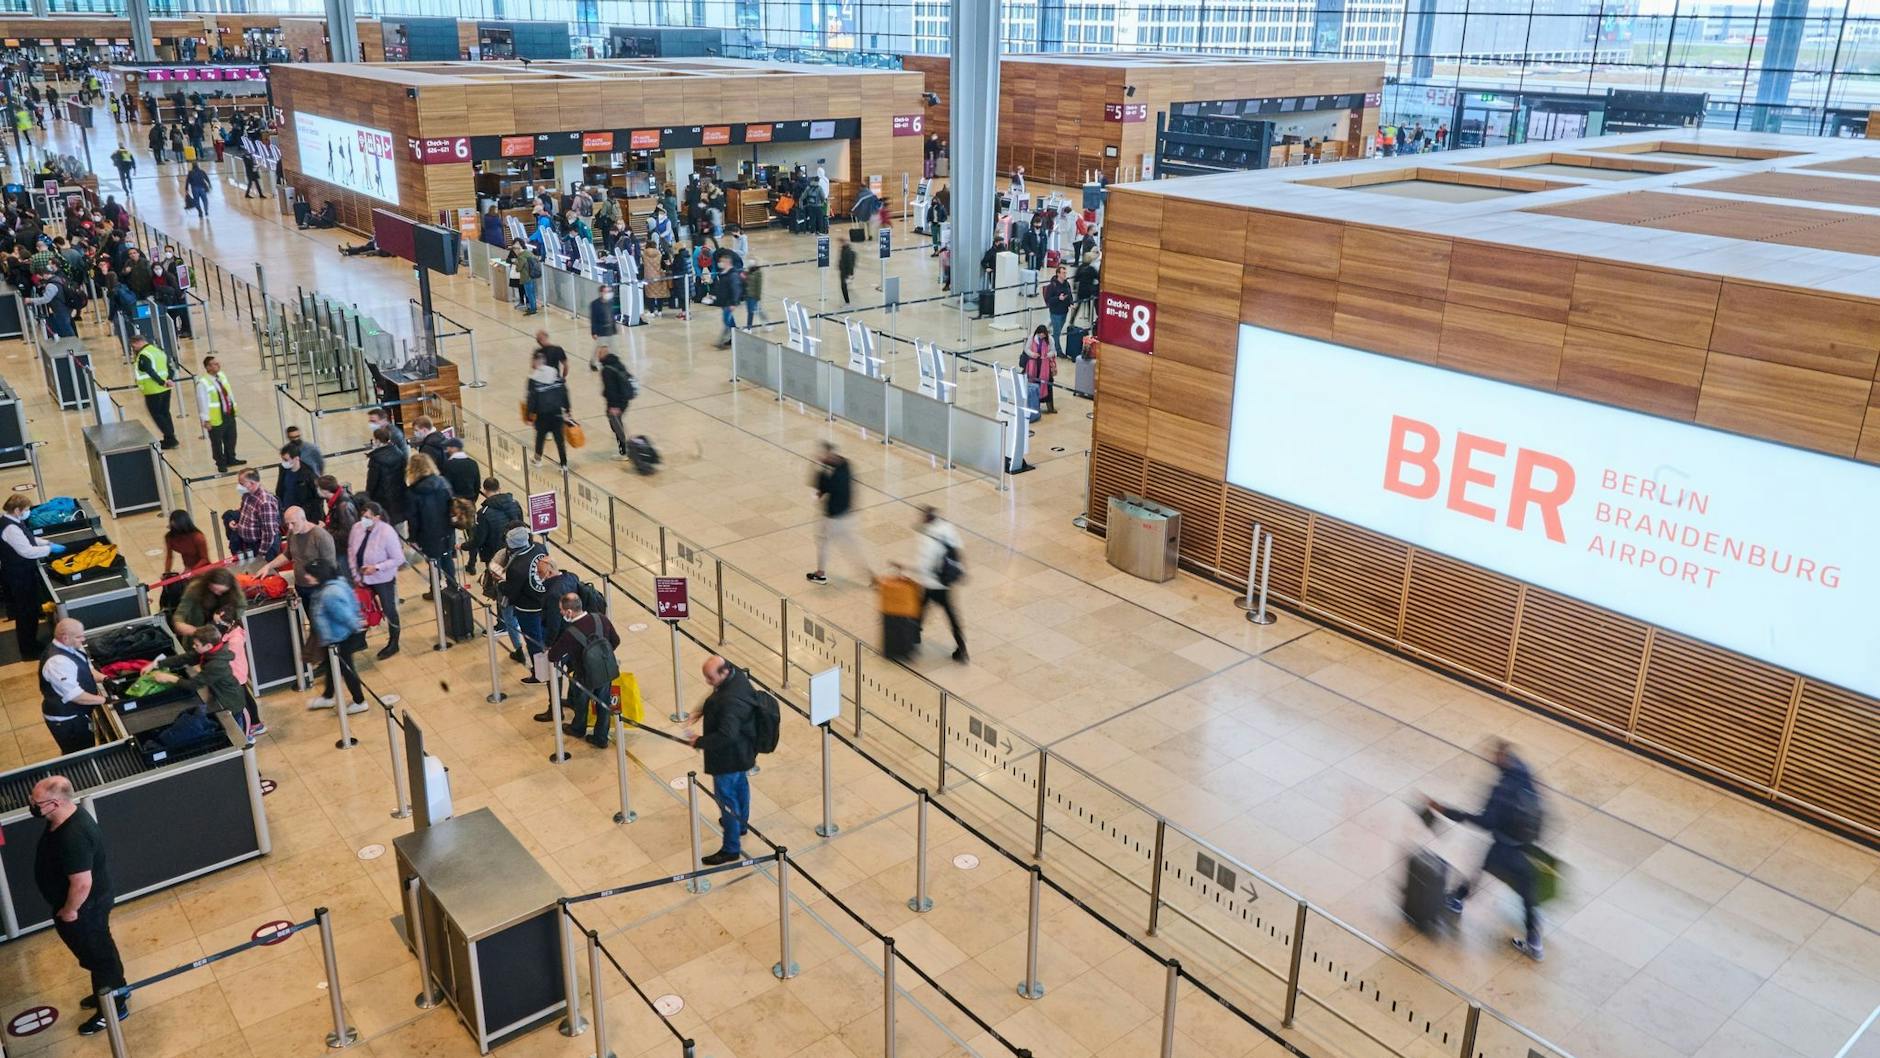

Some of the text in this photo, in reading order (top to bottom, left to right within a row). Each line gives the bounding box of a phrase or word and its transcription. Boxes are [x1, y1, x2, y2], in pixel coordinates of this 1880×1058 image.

[1114, 105, 1122, 119] 5
[1139, 104, 1147, 119] 5
[912, 116, 922, 132] 6
[415, 140, 421, 159] 6
[455, 138, 468, 158] 6
[1107, 298, 1130, 310] Check-in
[1131, 305, 1150, 342] 8
[1383, 414, 1576, 544] BER
[1602, 469, 1709, 515] BERLIN
[1596, 502, 1841, 589] BRANDENBURG
[1588, 535, 1720, 589] AIRPORT
[277, 928, 291, 938] BER
[193, 958, 208, 968] BER
